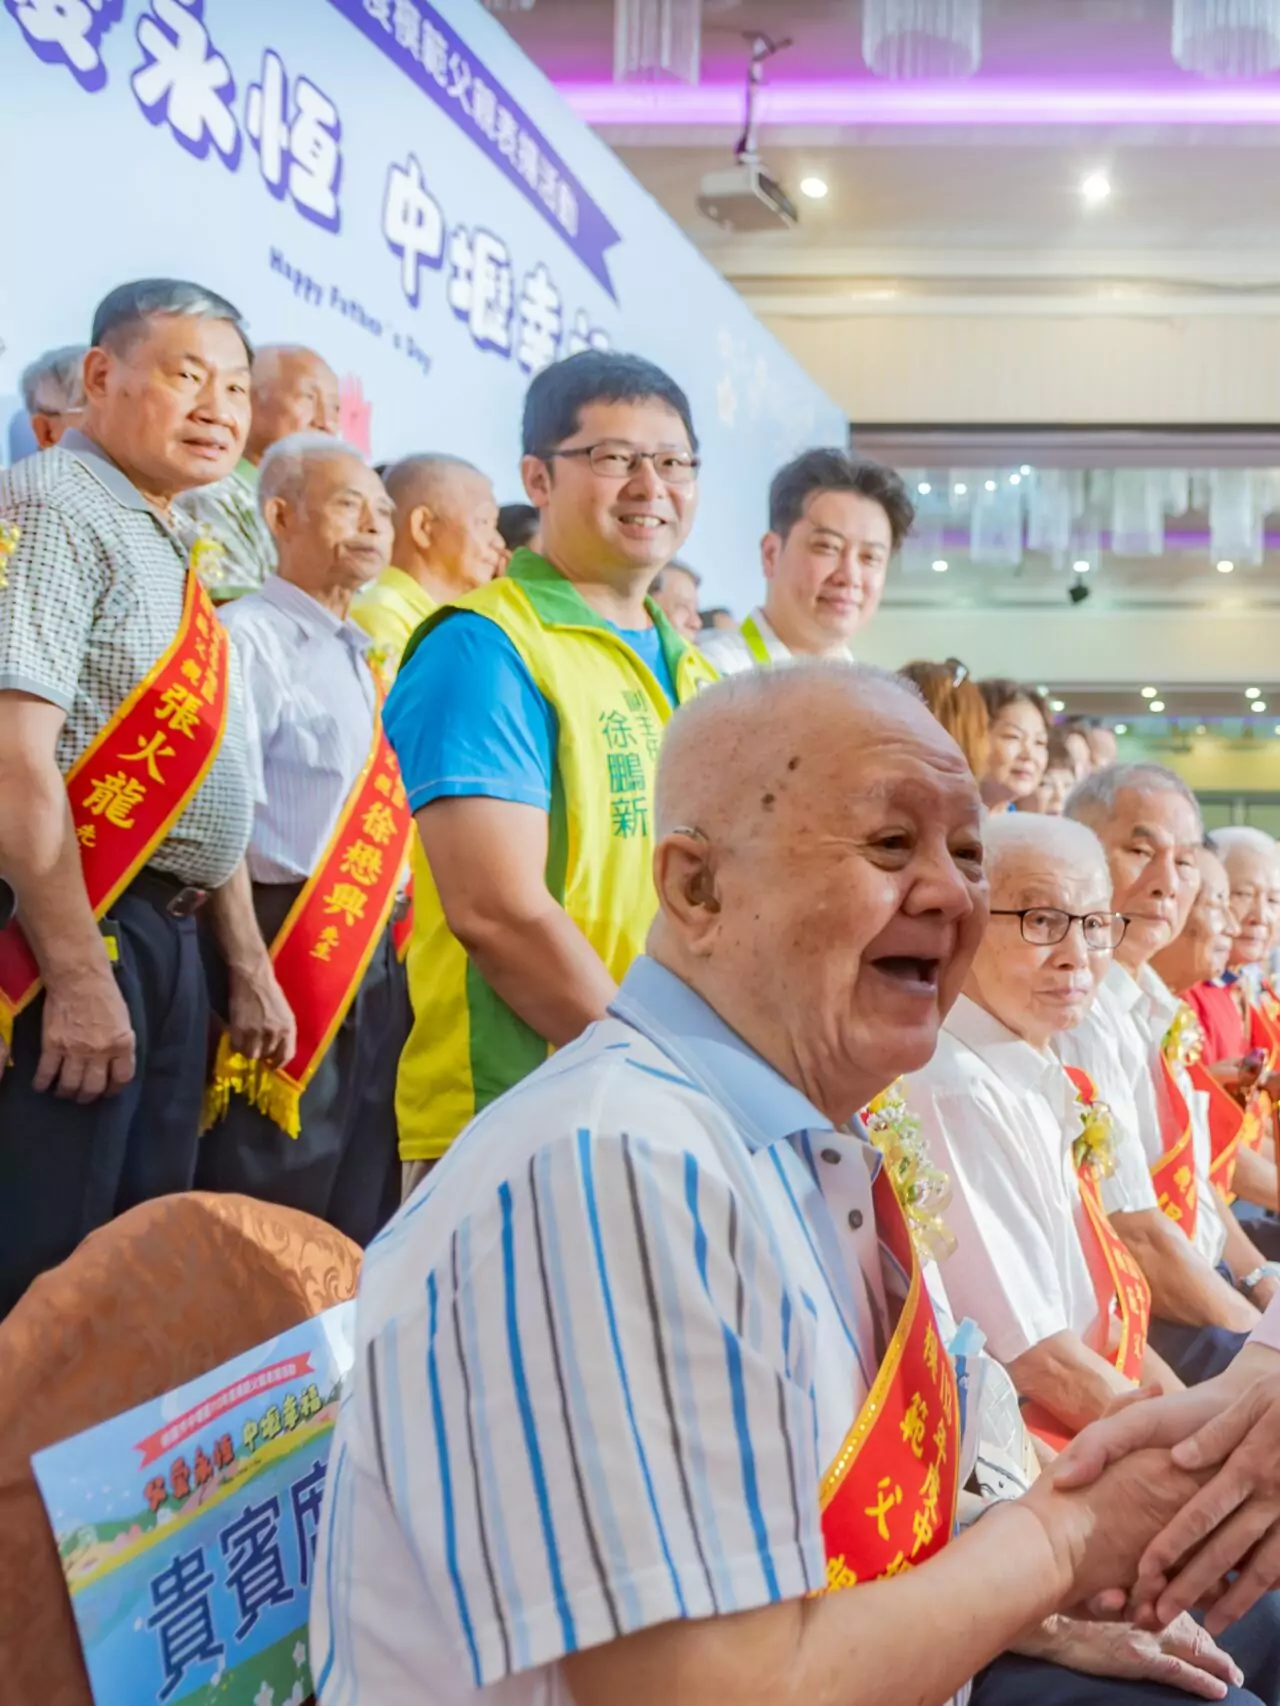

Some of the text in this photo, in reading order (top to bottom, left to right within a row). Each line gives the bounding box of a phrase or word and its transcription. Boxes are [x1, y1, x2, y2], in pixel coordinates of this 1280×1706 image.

[82, 683, 203, 829] 張火龍
[599, 710, 648, 839] 徐鵬新
